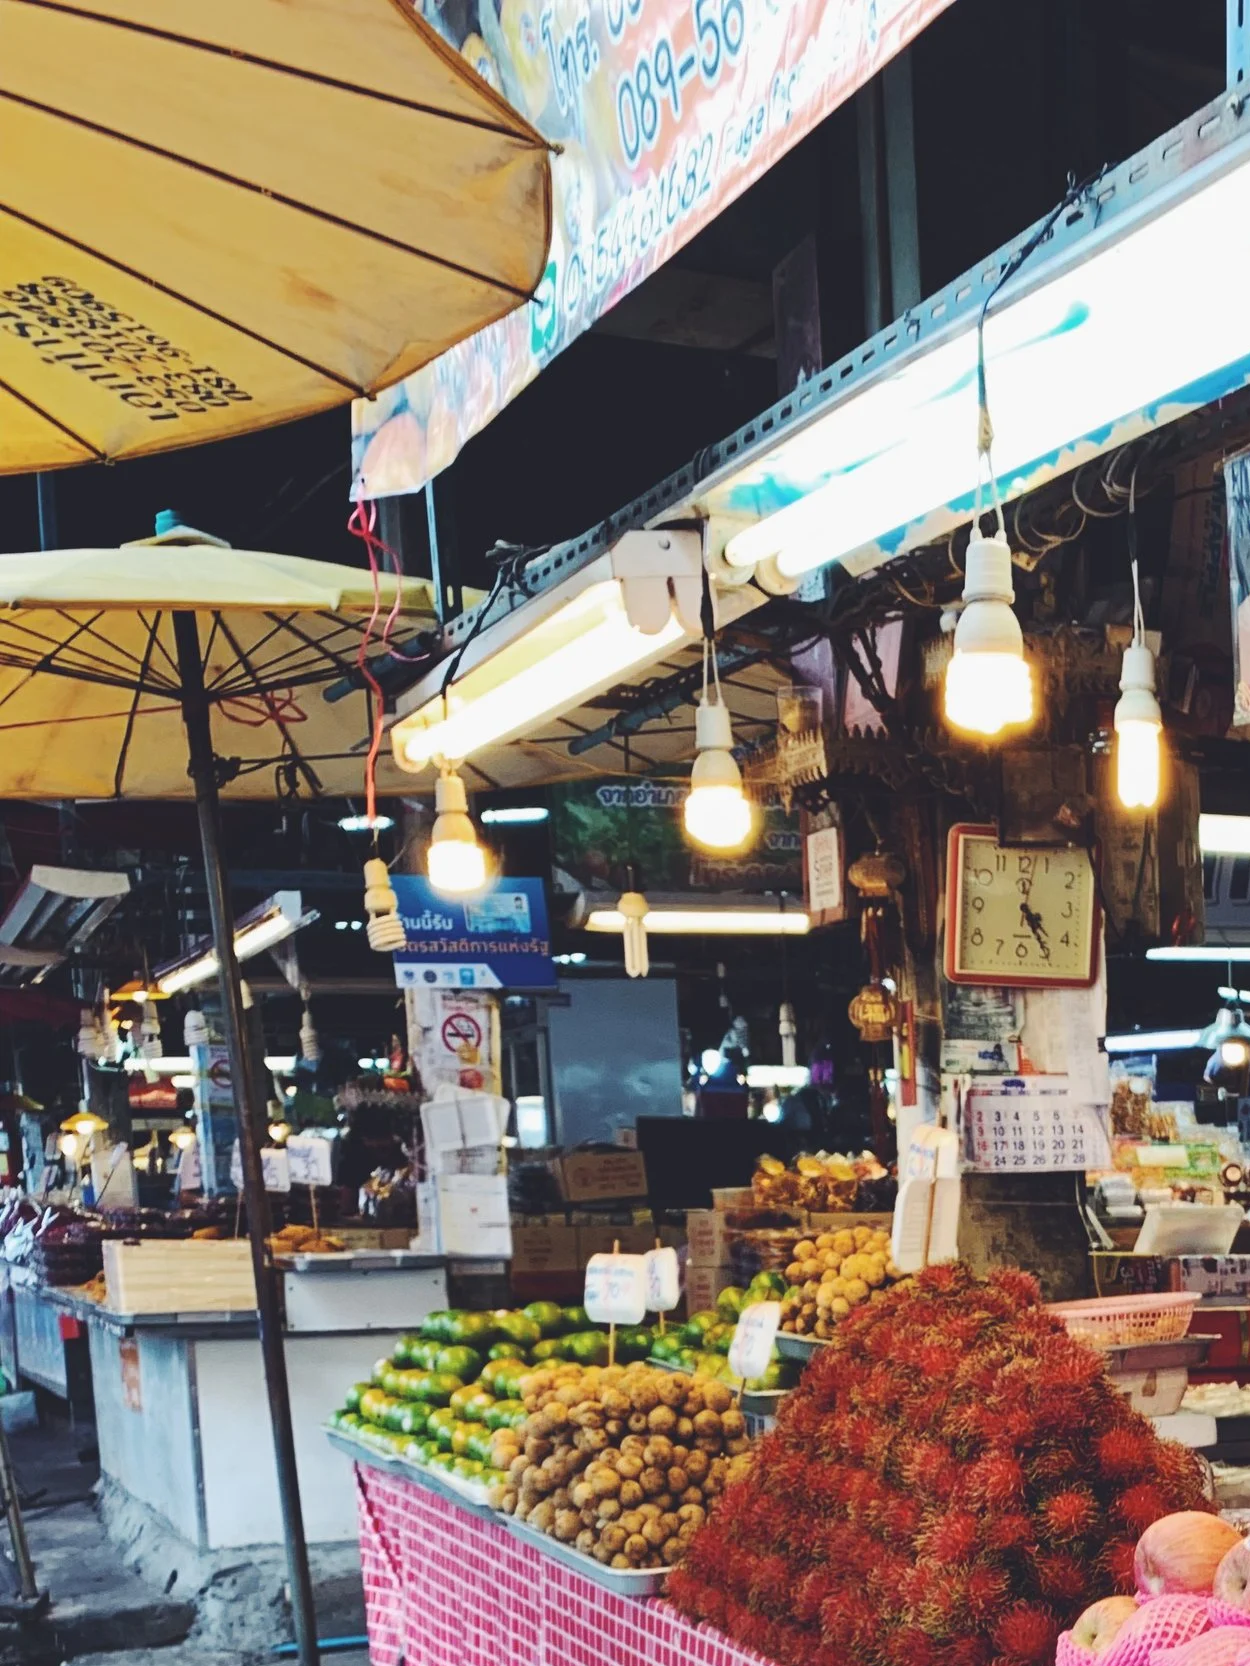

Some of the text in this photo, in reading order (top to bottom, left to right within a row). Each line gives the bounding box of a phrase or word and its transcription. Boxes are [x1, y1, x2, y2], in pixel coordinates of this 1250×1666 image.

[1018, 855, 1032, 874] 12
[1064, 871, 1075, 890] 2
[971, 896, 985, 914] 9
[1061, 901, 1073, 919] 3
[398, 909, 453, 931] ้านนี้รับ
[970, 927, 984, 946] 8
[1060, 932, 1070, 948] 4
[400, 936, 549, 956] ตรสวัสดิการแห่งรัฐ
[995, 939, 1004, 957] 7
[1015, 942, 1028, 958] 6
[993, 1126, 1005, 1136] 10
[1012, 1126, 1023, 1136] 11
[1032, 1126, 1044, 1136] 12
[1052, 1125, 1064, 1135] 13
[1072, 1125, 1084, 1135] 14
[1013, 1141, 1025, 1150] 18
[1033, 1141, 1045, 1150] 19
[1052, 1140, 1065, 1150] 20
[1072, 1140, 1084, 1149] 21
[994, 1156, 1007, 1166] 24
[1013, 1155, 1026, 1165] 25
[1033, 1155, 1046, 1165] 26
[1053, 1154, 1066, 1164] 27
[1073, 1153, 1086, 1163] 28
